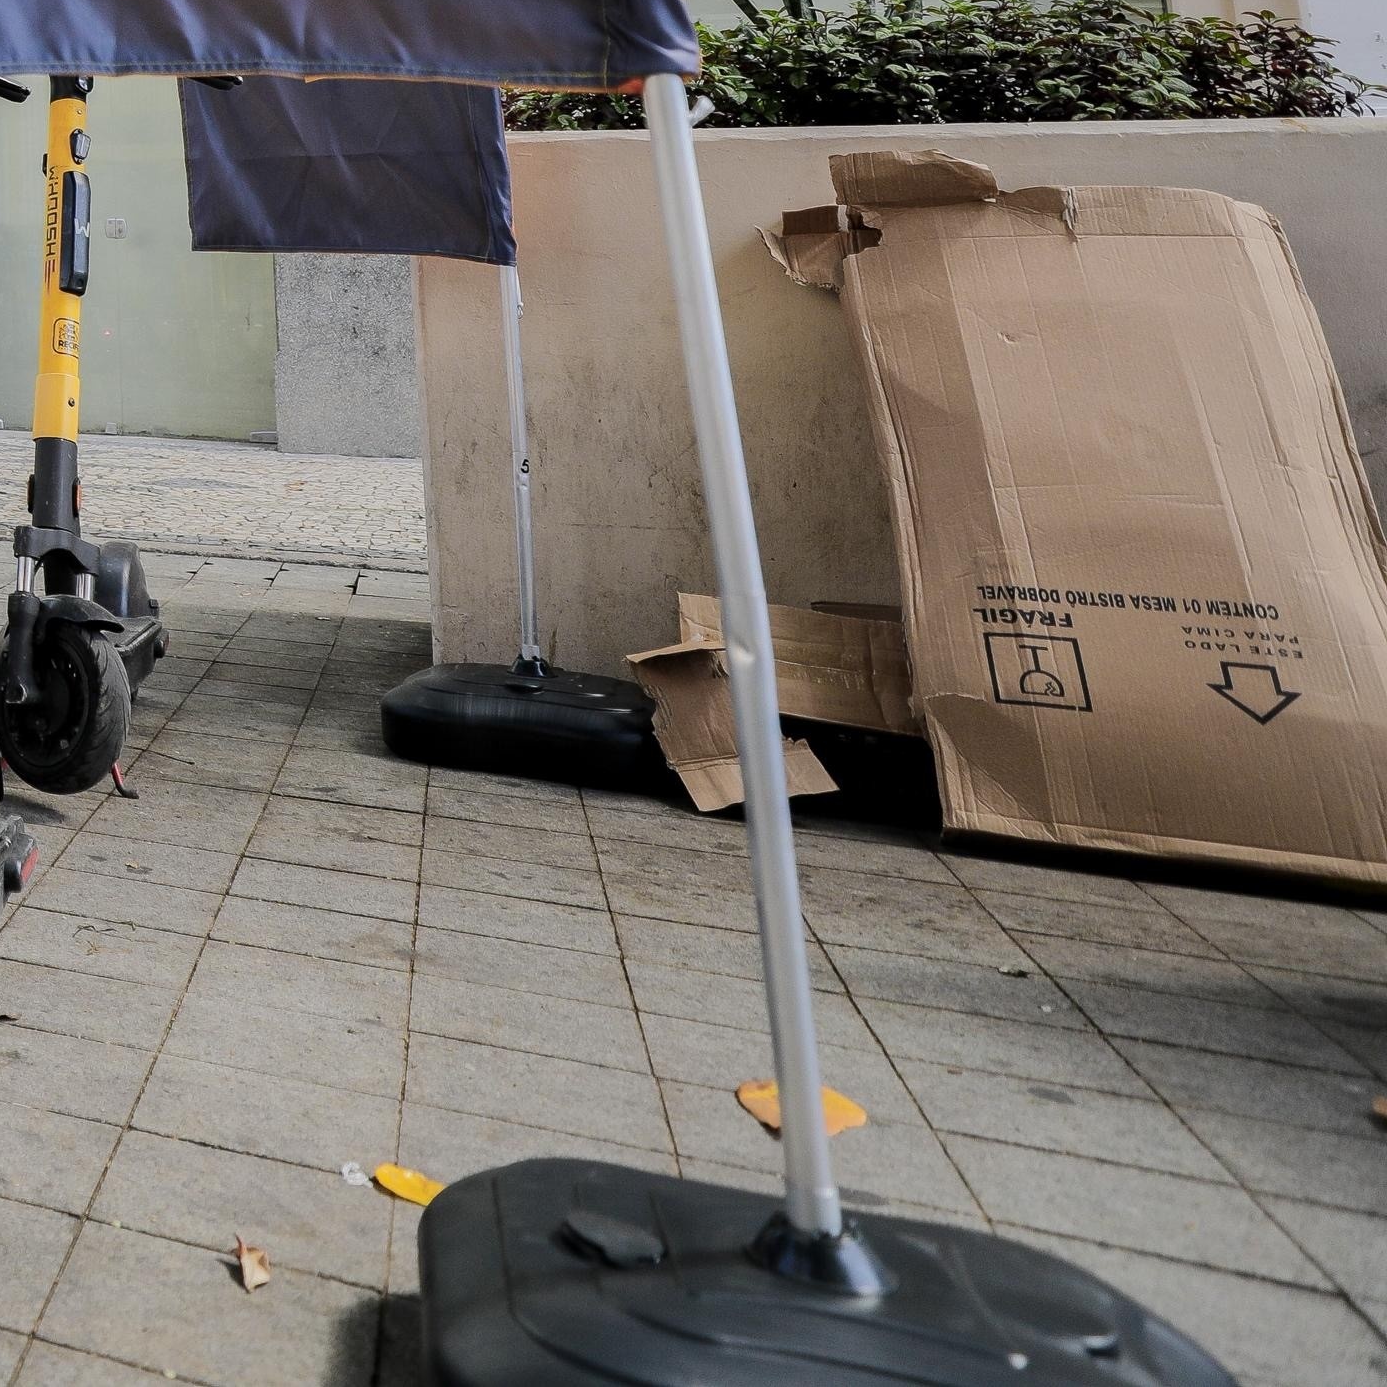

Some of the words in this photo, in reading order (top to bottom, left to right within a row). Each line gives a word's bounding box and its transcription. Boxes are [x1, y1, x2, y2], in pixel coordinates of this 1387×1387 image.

[46, 165, 59, 257] WHOOSH
[58, 339, 79, 351] RECIF
[977, 585, 1060, 605] DOBRÁVEL
[1065, 589, 1125, 610] BISTRÔ
[1129, 593, 1177, 613] MESA
[1182, 597, 1201, 614] 01
[1206, 600, 1279, 621] CONTÉM
[973, 607, 1074, 629] FRÁGIL
[1180, 625, 1235, 638] CIMA
[1243, 630, 1300, 645] PARA
[1184, 639, 1241, 653] LADO
[1248, 644, 1304, 660] ESTE
